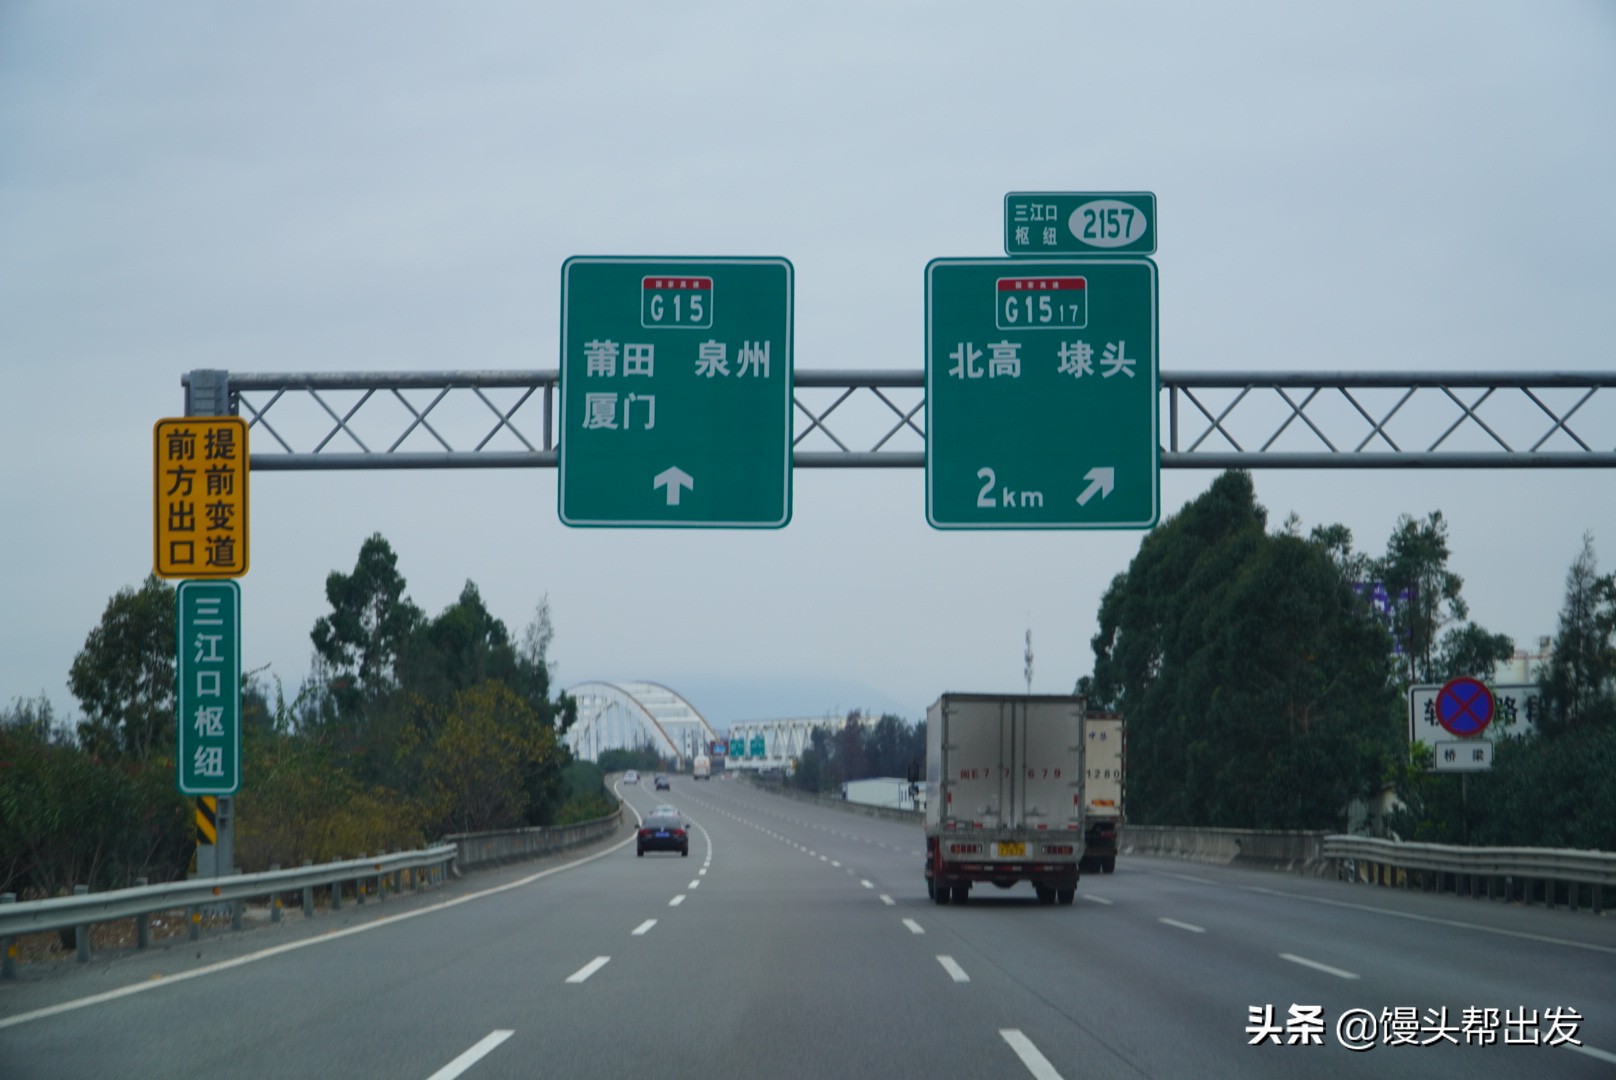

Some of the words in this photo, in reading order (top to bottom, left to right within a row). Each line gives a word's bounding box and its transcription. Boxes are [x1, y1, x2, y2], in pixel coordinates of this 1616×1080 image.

[1014, 203, 1058, 222] 三江口
[1083, 208, 1135, 239] 2157
[1015, 226, 1058, 246] 枢纽
[650, 294, 704, 322] G15
[583, 339, 655, 378] 莆田
[694, 340, 771, 379] 泉州
[949, 340, 1022, 379] 北高
[1057, 340, 1136, 379] 埭头
[582, 392, 656, 430] 厦门
[166, 428, 197, 566] 前方出口
[204, 428, 236, 567] 提前变道
[193, 598, 225, 777] 三江口枢纽
